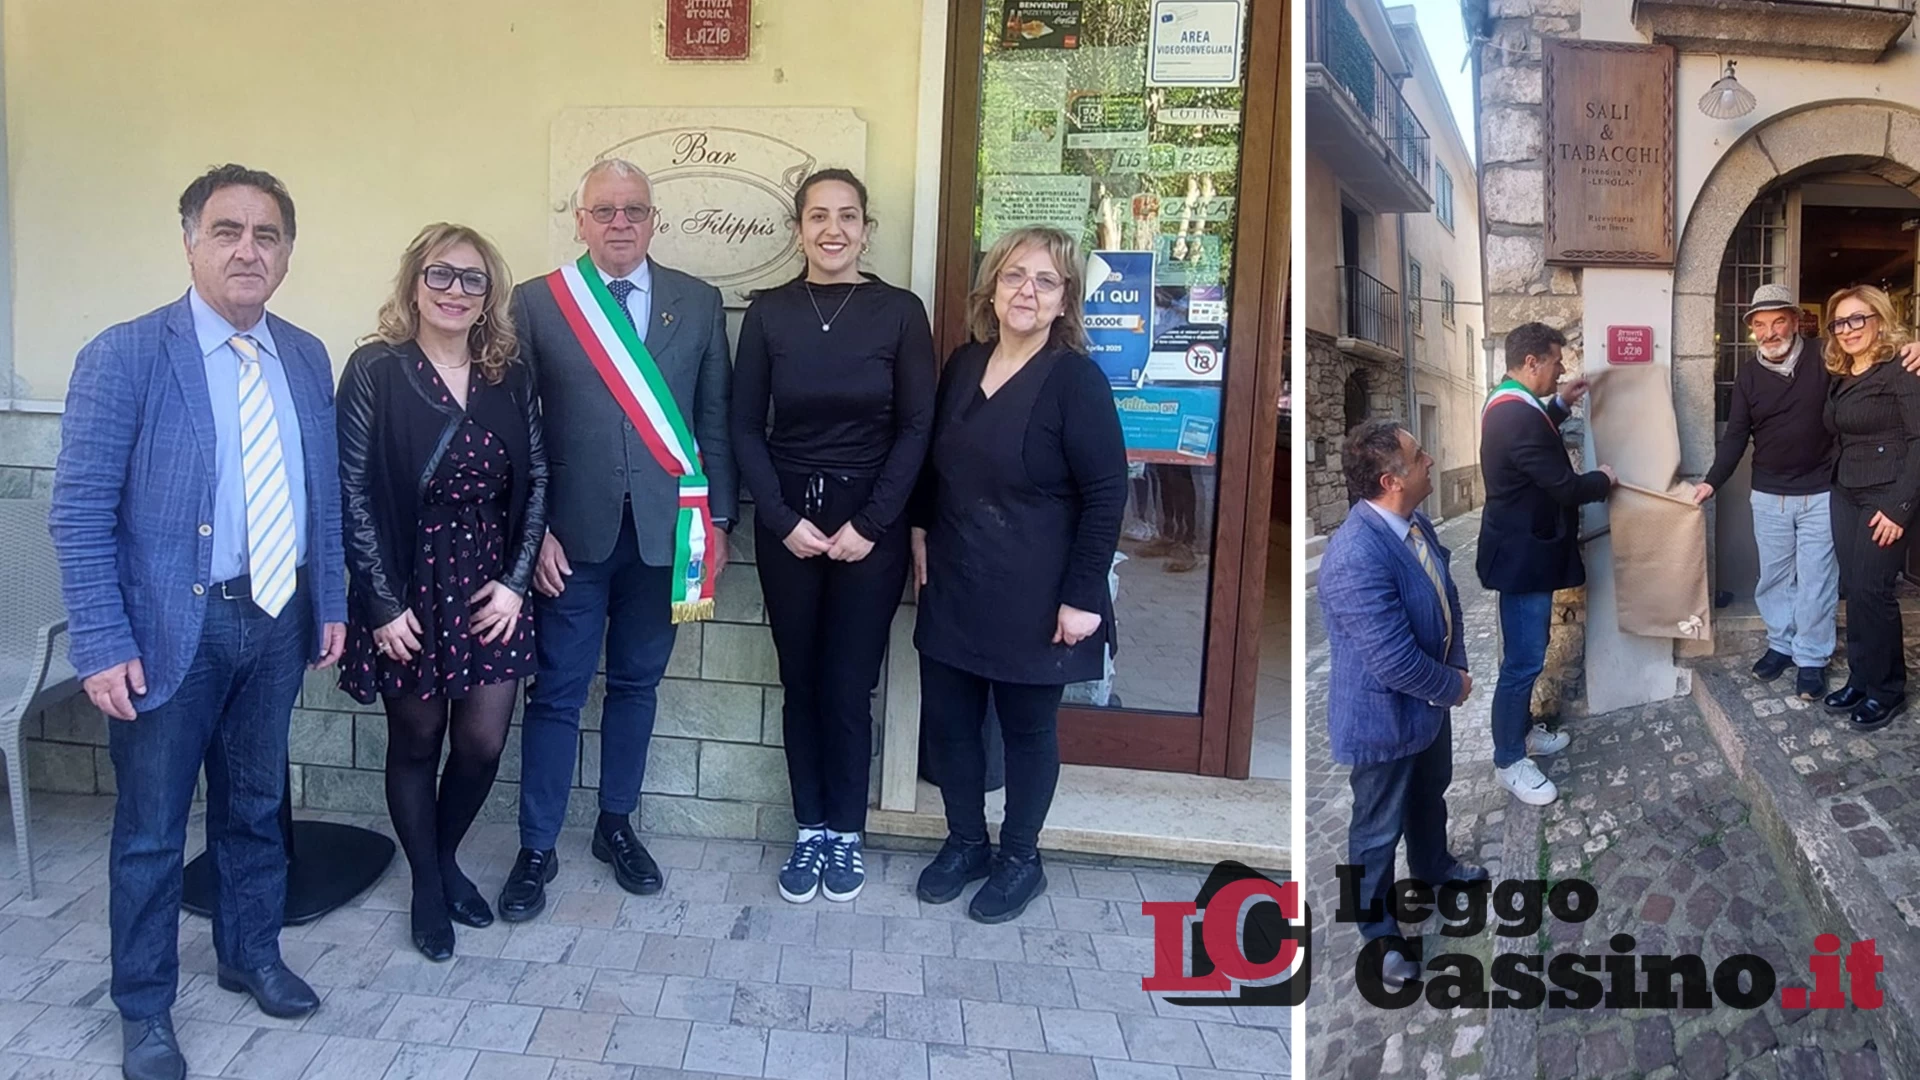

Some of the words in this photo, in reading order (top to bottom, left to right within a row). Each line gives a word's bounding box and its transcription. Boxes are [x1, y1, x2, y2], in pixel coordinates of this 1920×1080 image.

[686, 9, 731, 19] STORICA
[686, 28, 731, 45] LAZIO
[1180, 31, 1210, 43] AREA
[1157, 45, 1233, 55] VIDEOSORVEGLIATA
[1585, 102, 1630, 120] SALI
[1600, 123, 1614, 141] &
[672, 131, 737, 165] Bar
[1558, 143, 1661, 164] TABACCHI
[681, 208, 777, 244] Filippis
[1110, 290, 1139, 303] QUI
[1617, 346, 1643, 356] LAZIO
[1192, 355, 1210, 369] 18
